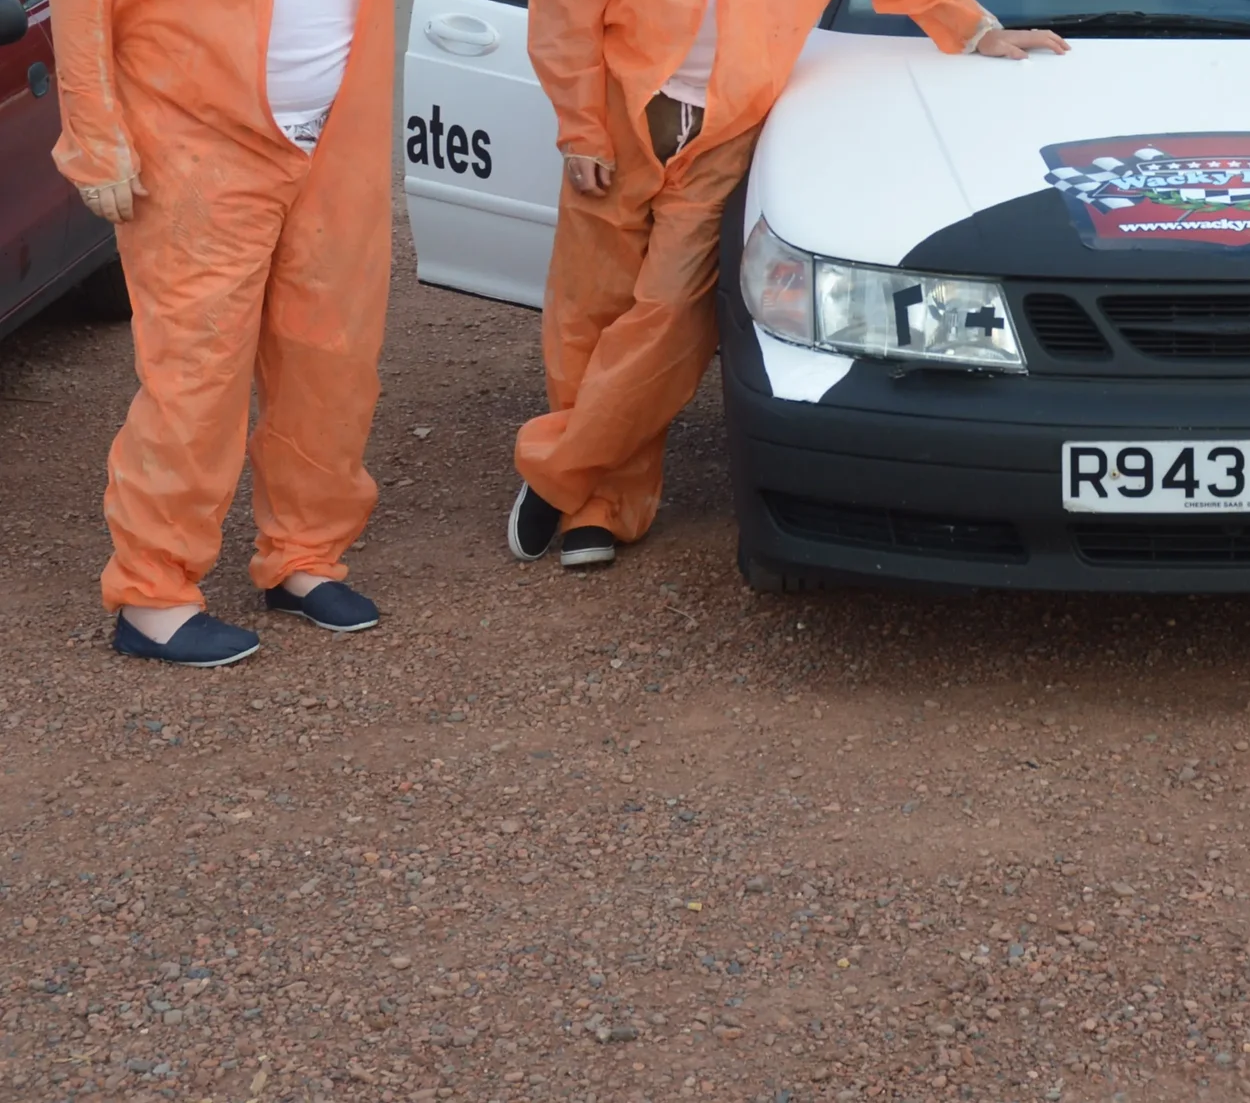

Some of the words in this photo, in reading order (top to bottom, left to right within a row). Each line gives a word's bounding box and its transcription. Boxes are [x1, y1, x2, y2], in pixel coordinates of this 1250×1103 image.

[406, 104, 493, 180] ates
[1109, 170, 1242, 191] Wacky
[1069, 446, 1246, 499] R943
[1184, 501, 1222, 509] CHESHIRE
[1223, 501, 1244, 509] SAAB
